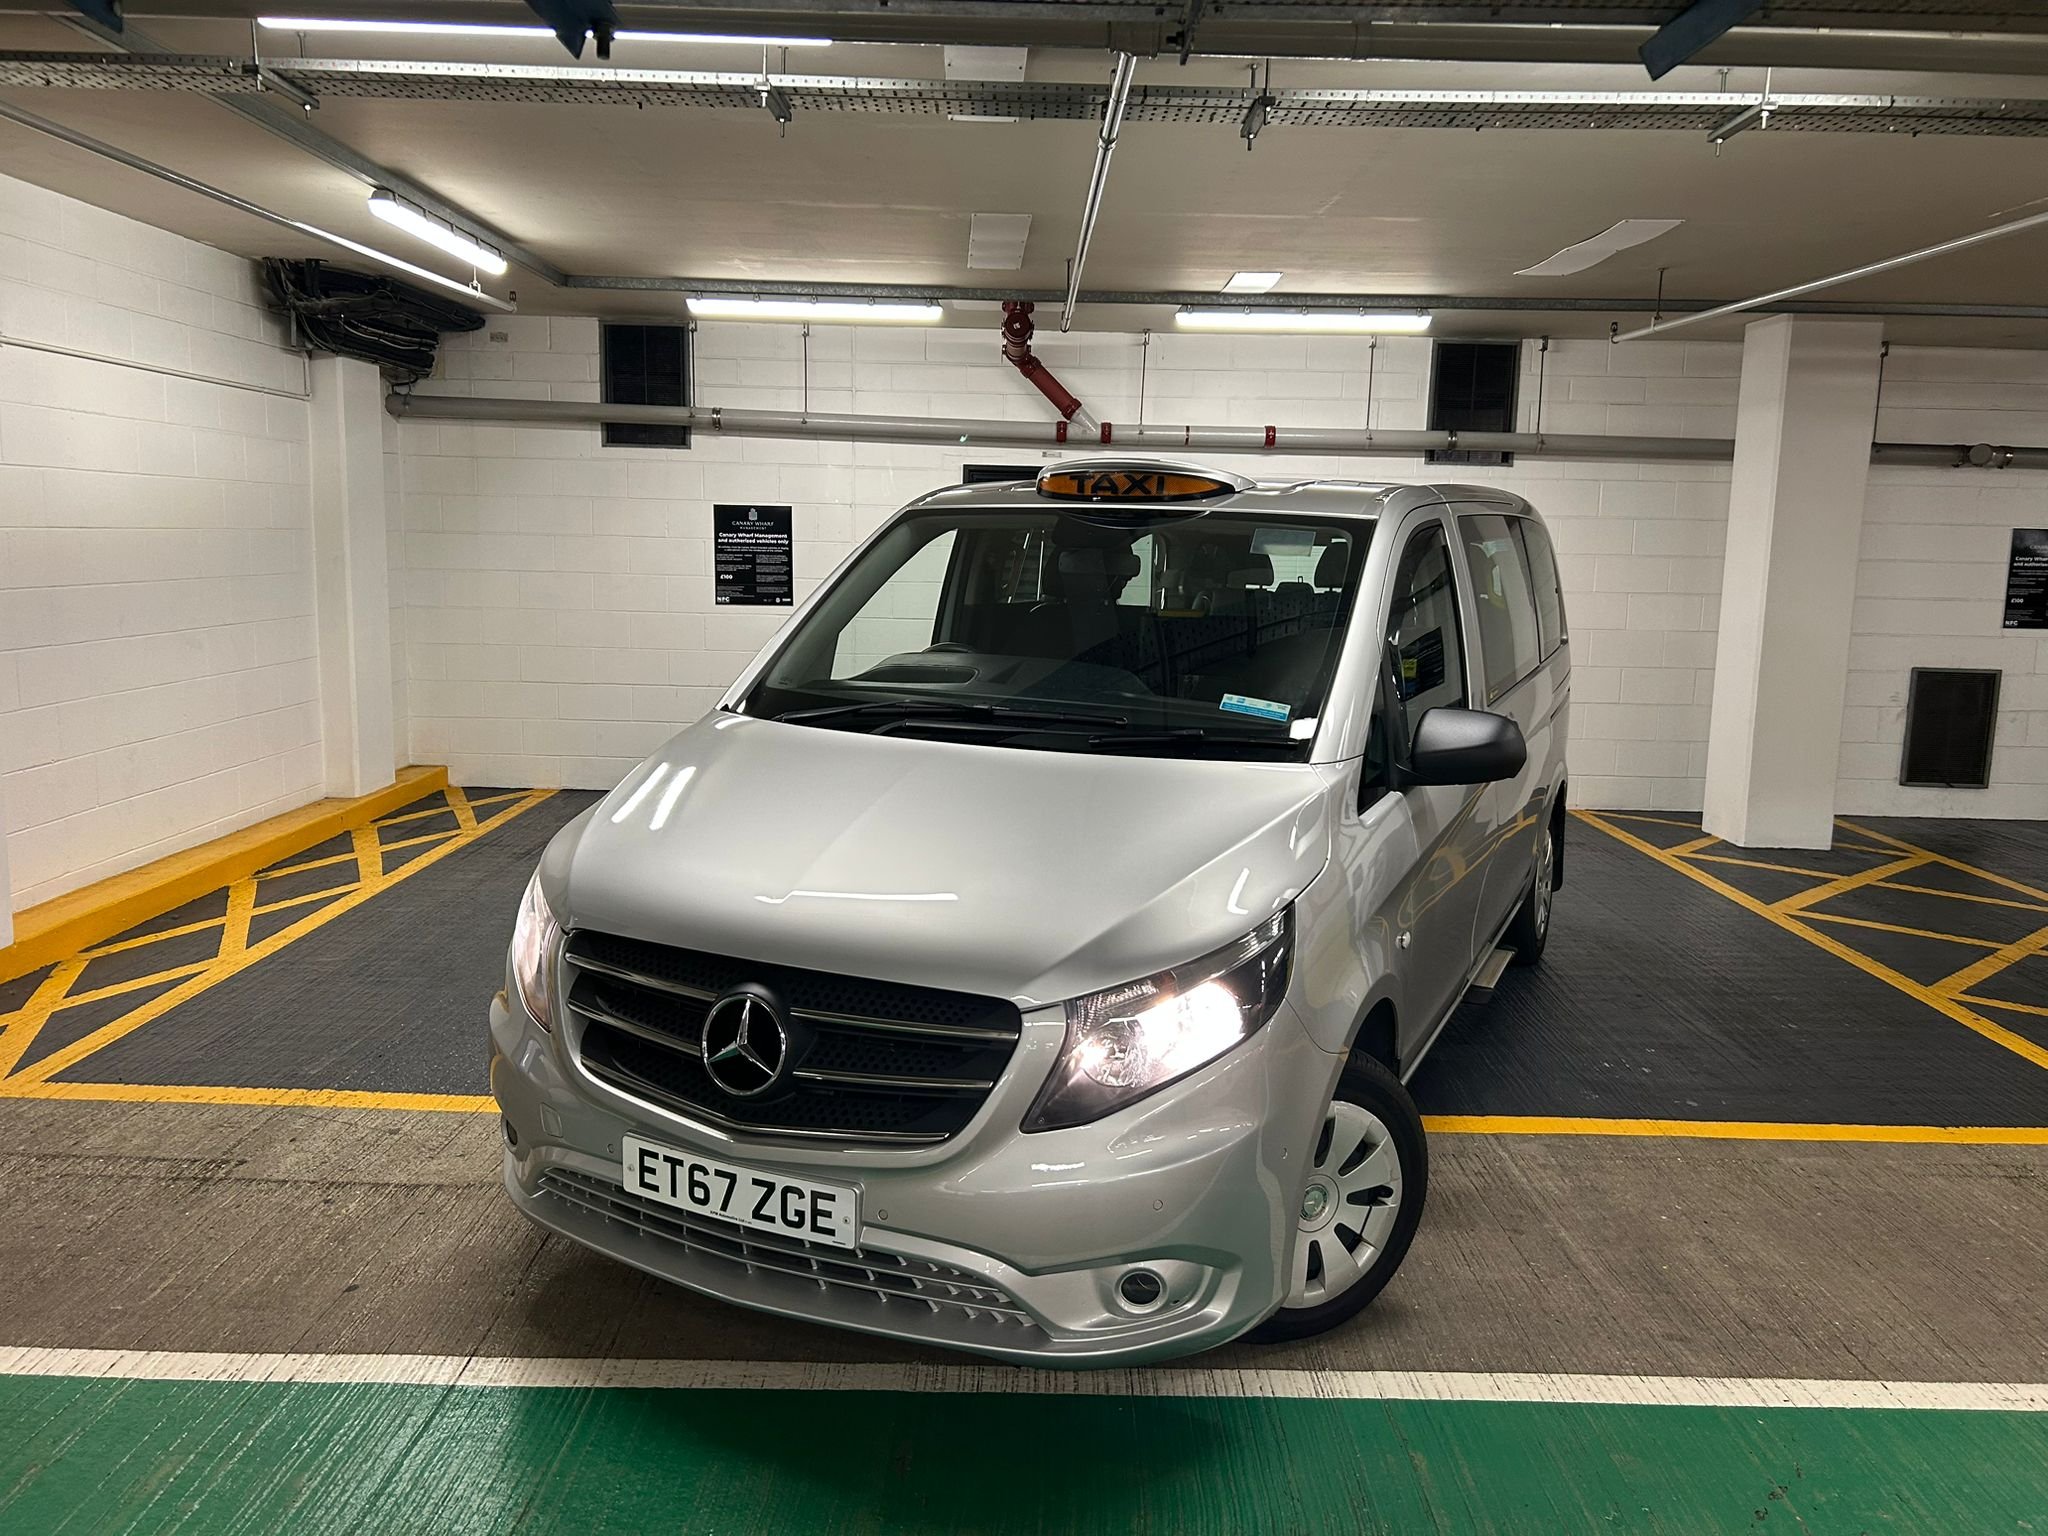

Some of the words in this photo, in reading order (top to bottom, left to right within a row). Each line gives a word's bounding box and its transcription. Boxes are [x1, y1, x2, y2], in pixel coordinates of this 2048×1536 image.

[1068, 474, 1167, 495] TAXI
[638, 1147, 738, 1212] ET67
[751, 1177, 836, 1237] ZGE
